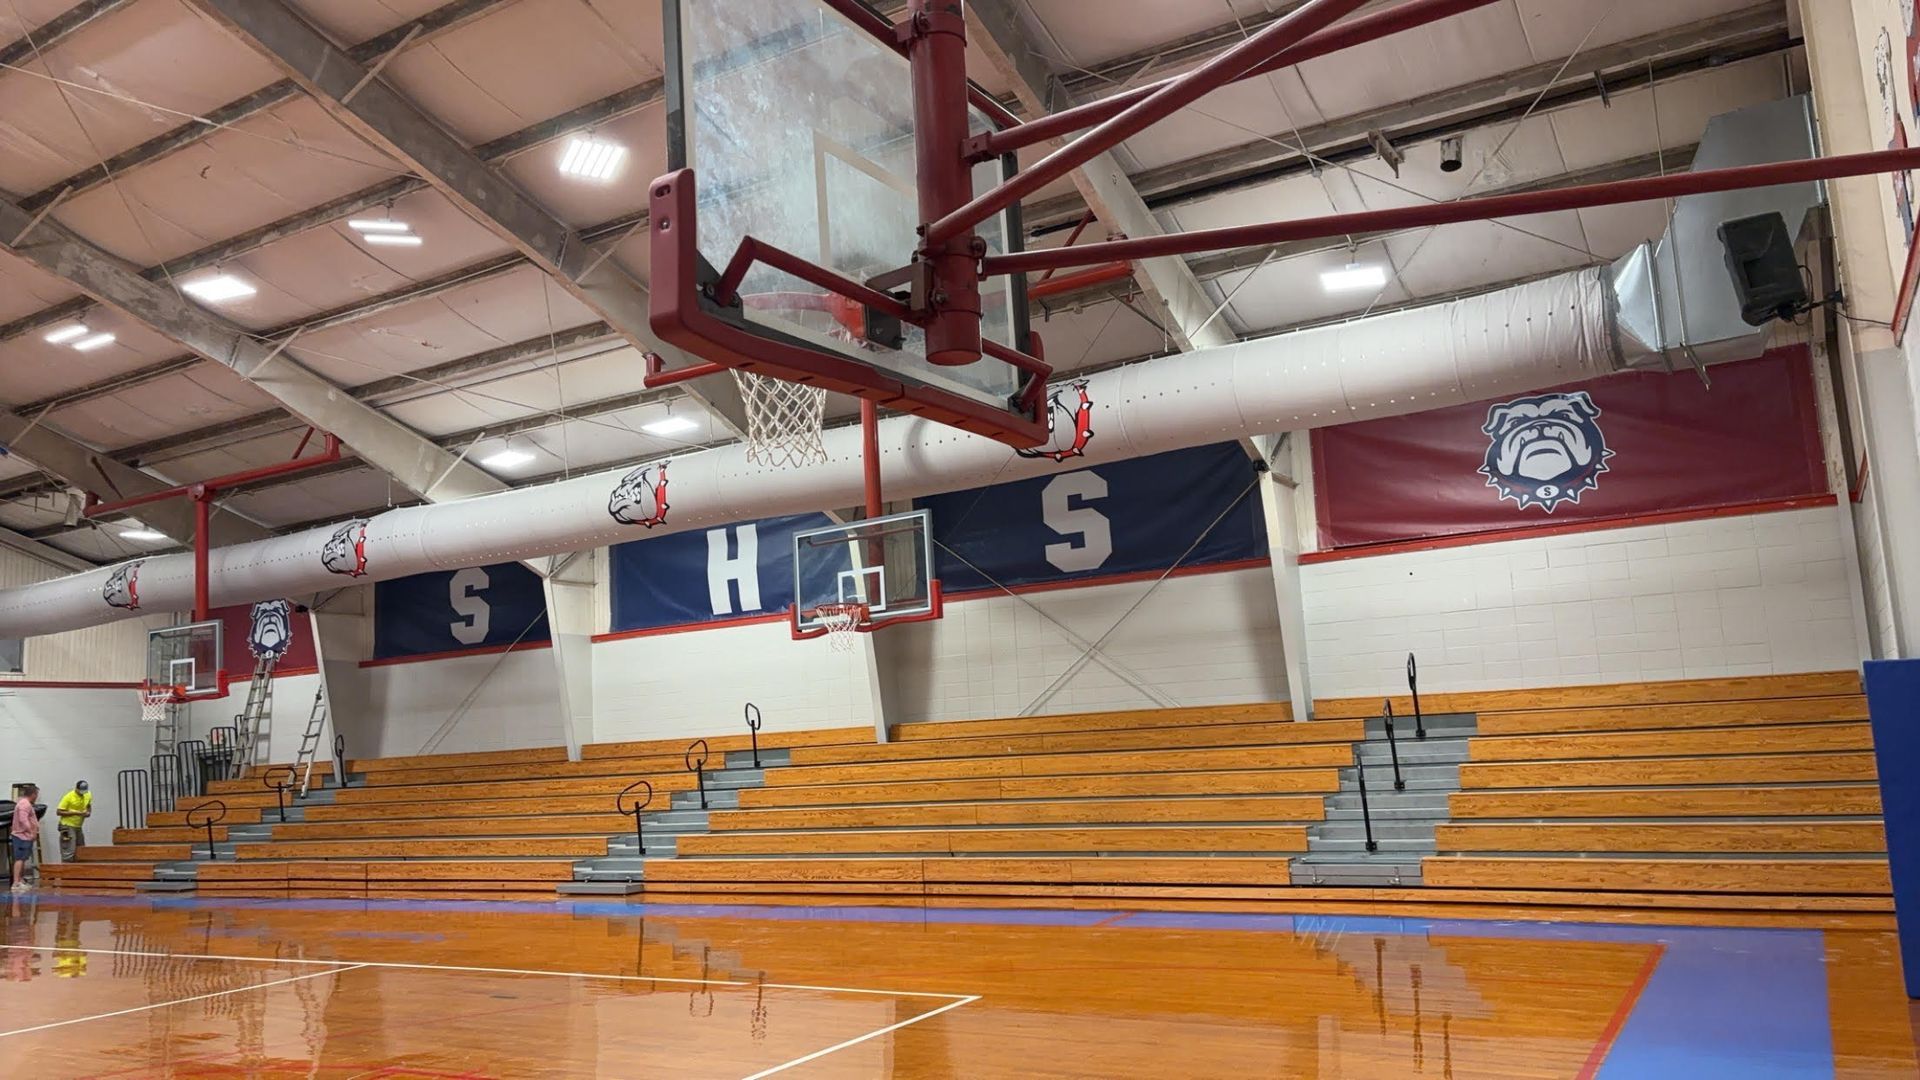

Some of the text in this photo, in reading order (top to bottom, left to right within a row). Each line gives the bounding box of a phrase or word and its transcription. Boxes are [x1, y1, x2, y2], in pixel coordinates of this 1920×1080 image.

[1042, 470, 1112, 573] S
[1543, 487, 1551, 496] S
[449, 566, 490, 644] S
[707, 523, 762, 615] H
